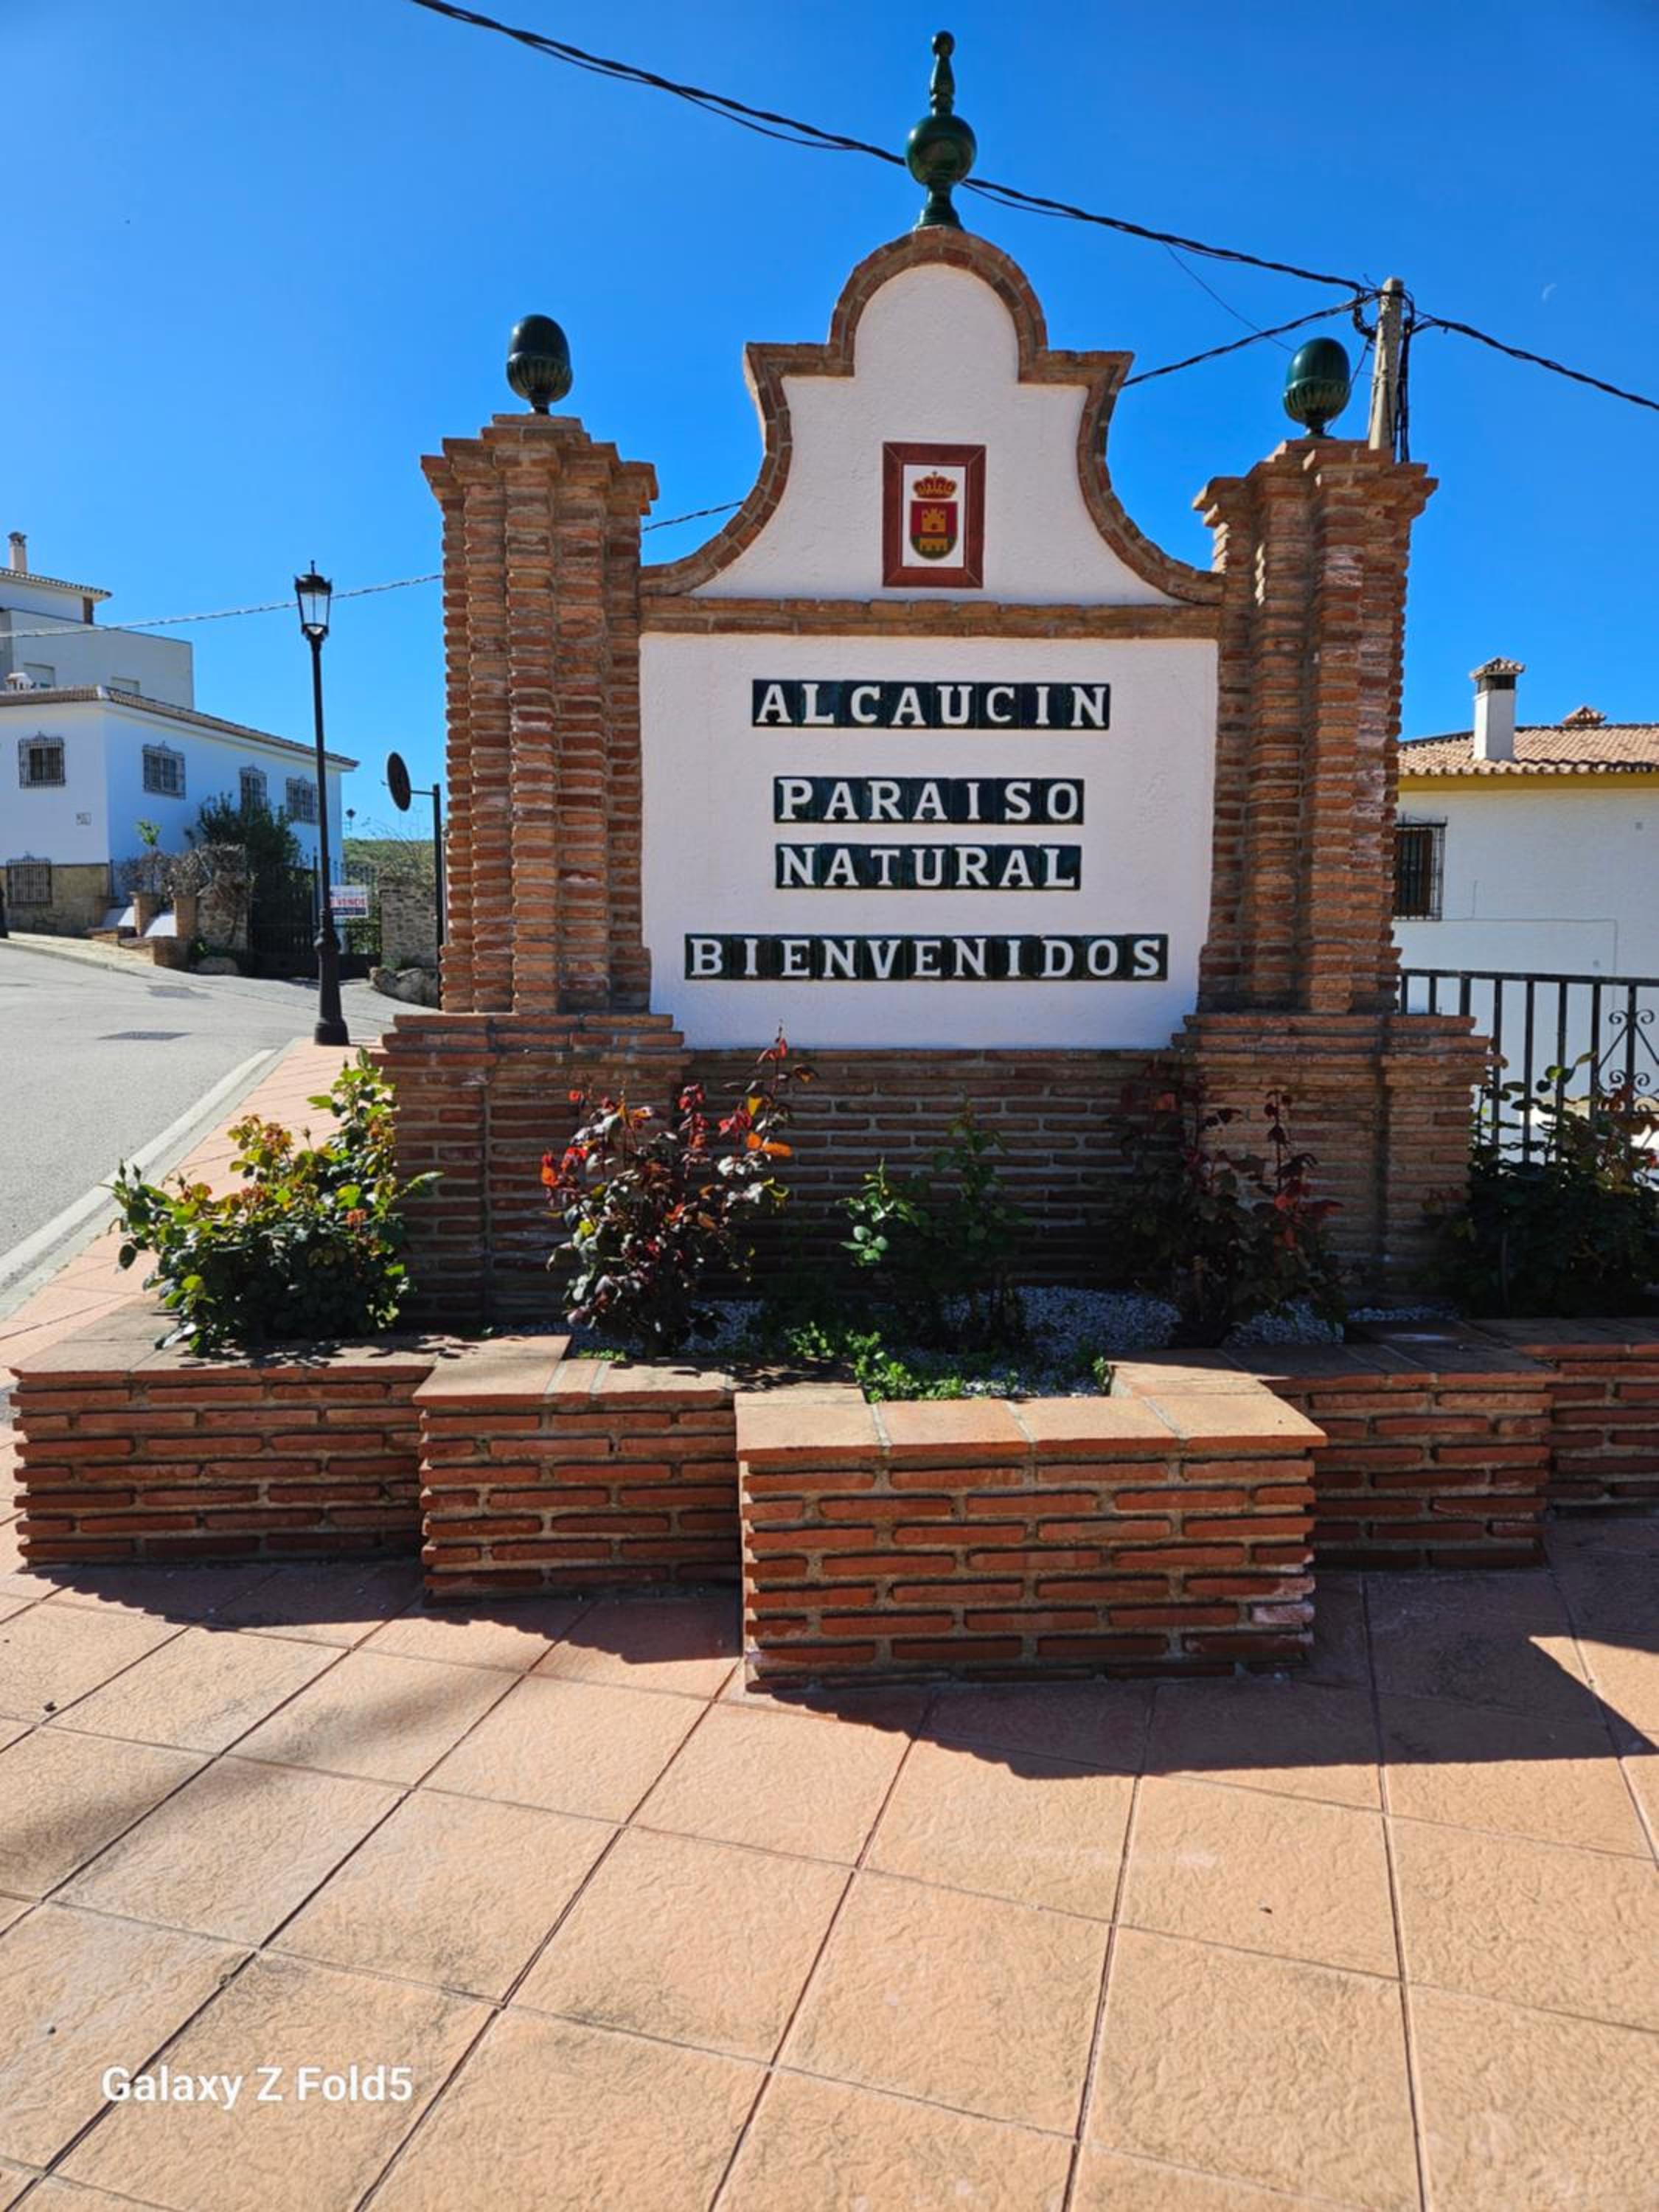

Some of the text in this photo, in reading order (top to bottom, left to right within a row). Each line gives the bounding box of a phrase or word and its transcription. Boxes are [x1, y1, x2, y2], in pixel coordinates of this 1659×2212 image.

[755, 683, 1107, 727] ALCAUCIN
[778, 779, 1079, 821] PARAISO
[782, 846, 1076, 887] NATURAL
[689, 938, 1161, 978] BIENVENIDOS
